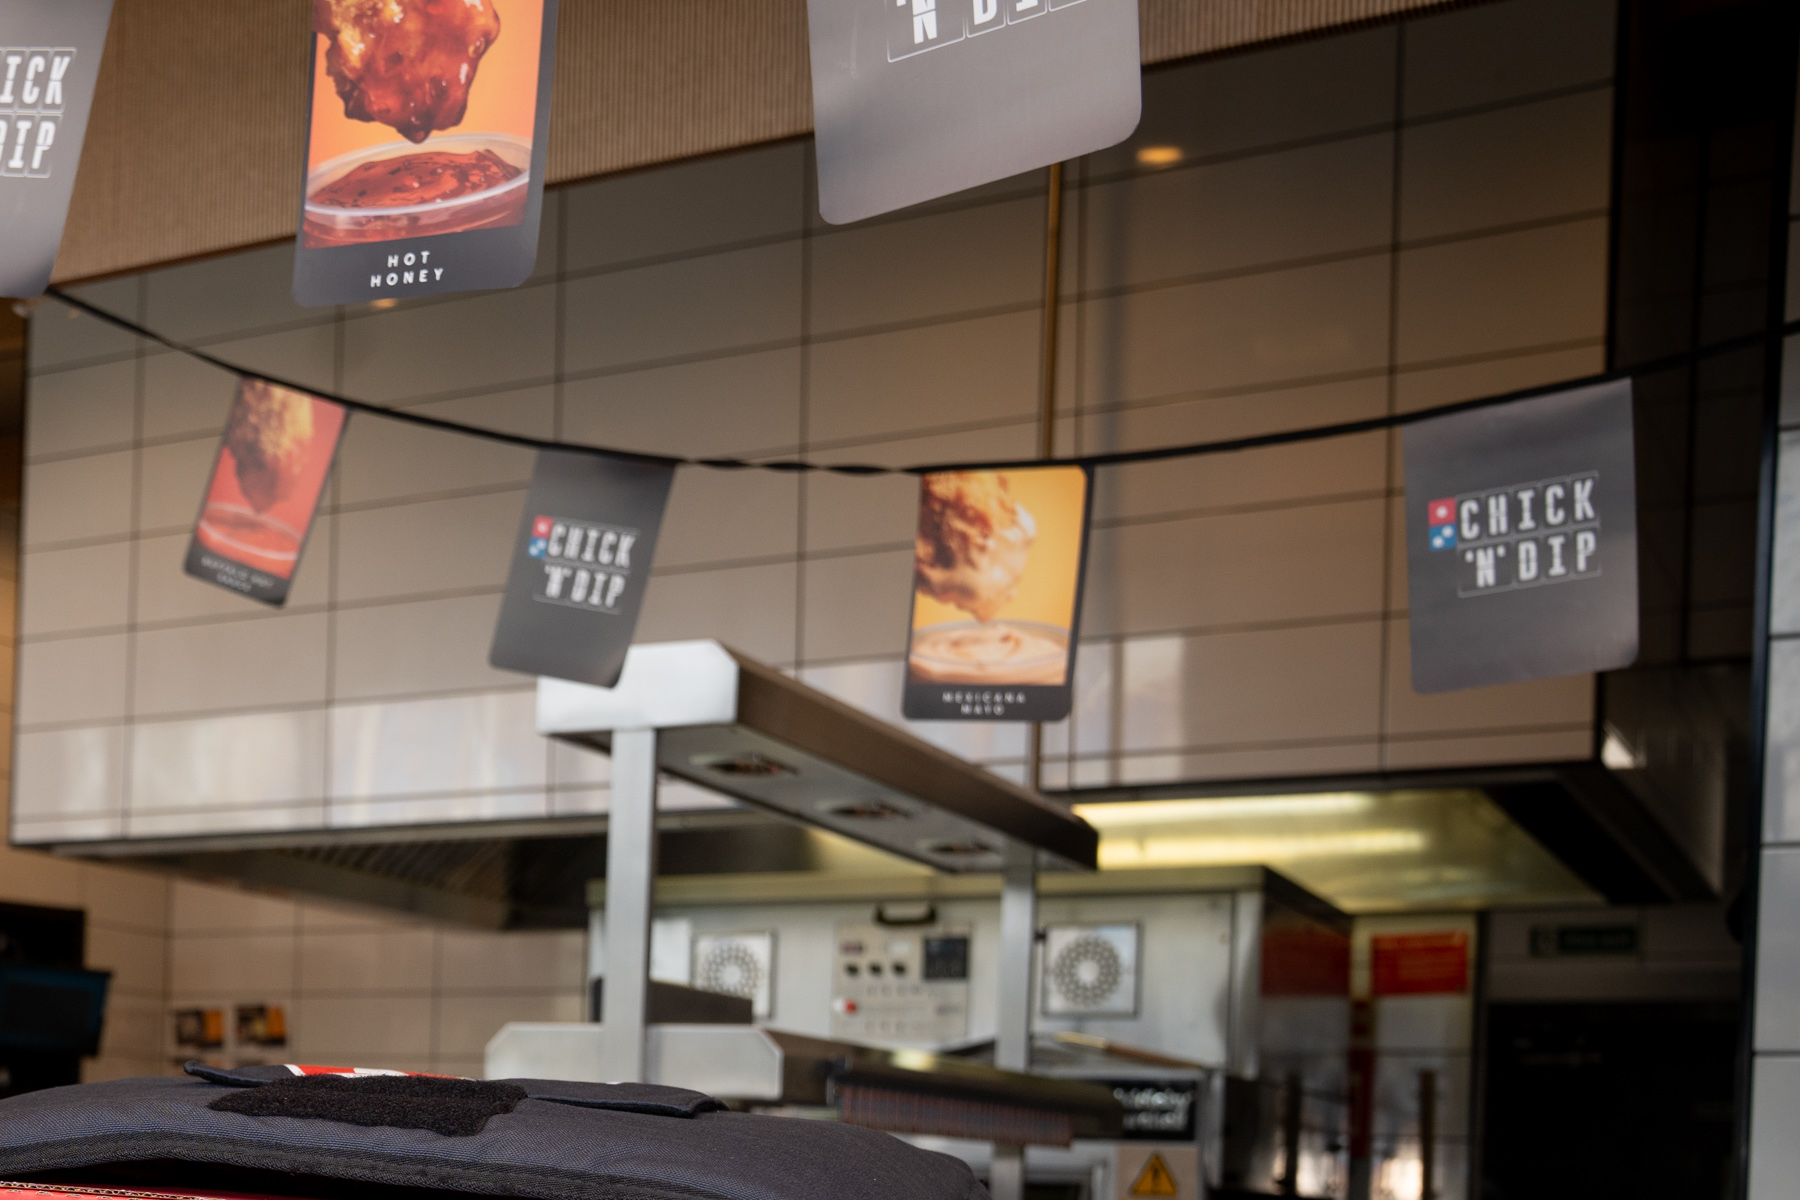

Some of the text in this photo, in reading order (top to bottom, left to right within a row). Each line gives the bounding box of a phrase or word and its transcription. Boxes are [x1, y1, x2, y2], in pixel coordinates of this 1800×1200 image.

[387, 250, 431, 268] HOT
[370, 267, 444, 288] HONEY
[1460, 478, 1595, 540] CHICK
[547, 523, 636, 568] CHICK
[1518, 530, 1597, 582] DIP
[570, 568, 626, 608] DIP
[942, 690, 1026, 704] MEXICANA
[960, 703, 1005, 716] MAYO
